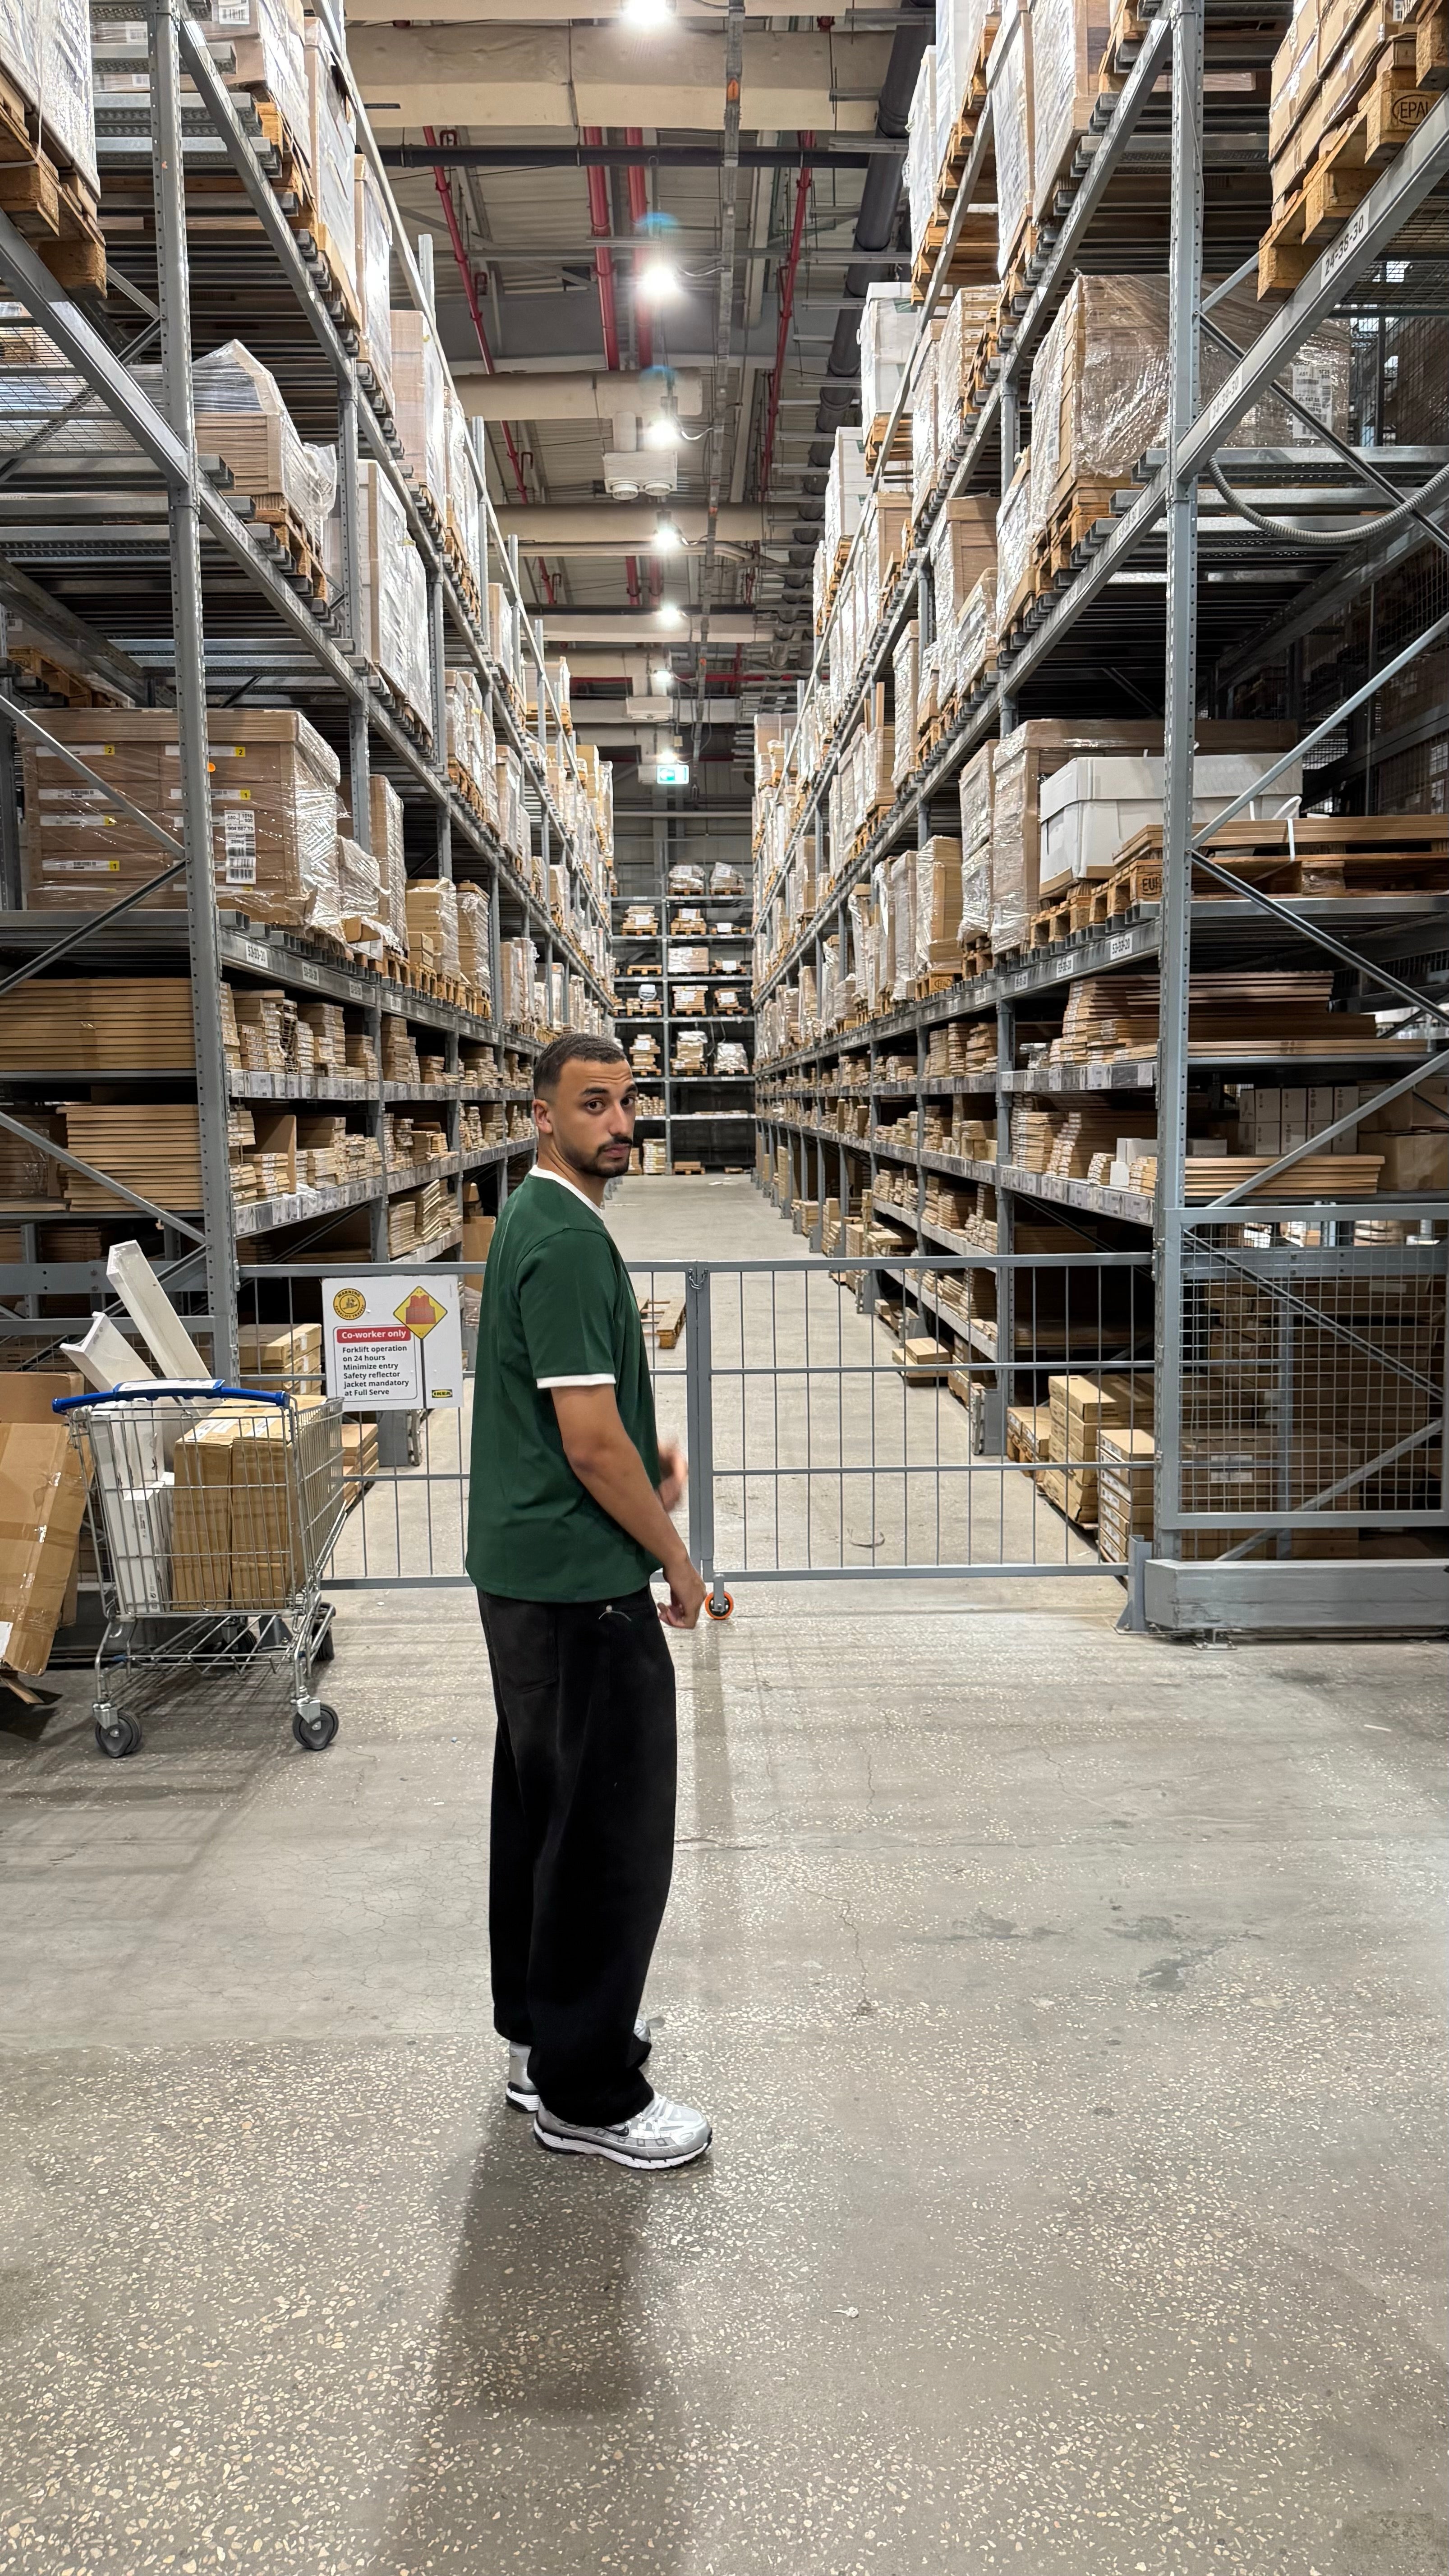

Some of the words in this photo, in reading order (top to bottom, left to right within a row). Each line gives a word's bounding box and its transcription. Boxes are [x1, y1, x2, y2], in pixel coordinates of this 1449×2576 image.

[1325, 215, 1364, 277] 24-38-30
[341, 1330, 386, 1339] Co-worker
[387, 1329, 406, 1339] only
[371, 1345, 407, 1353] operation
